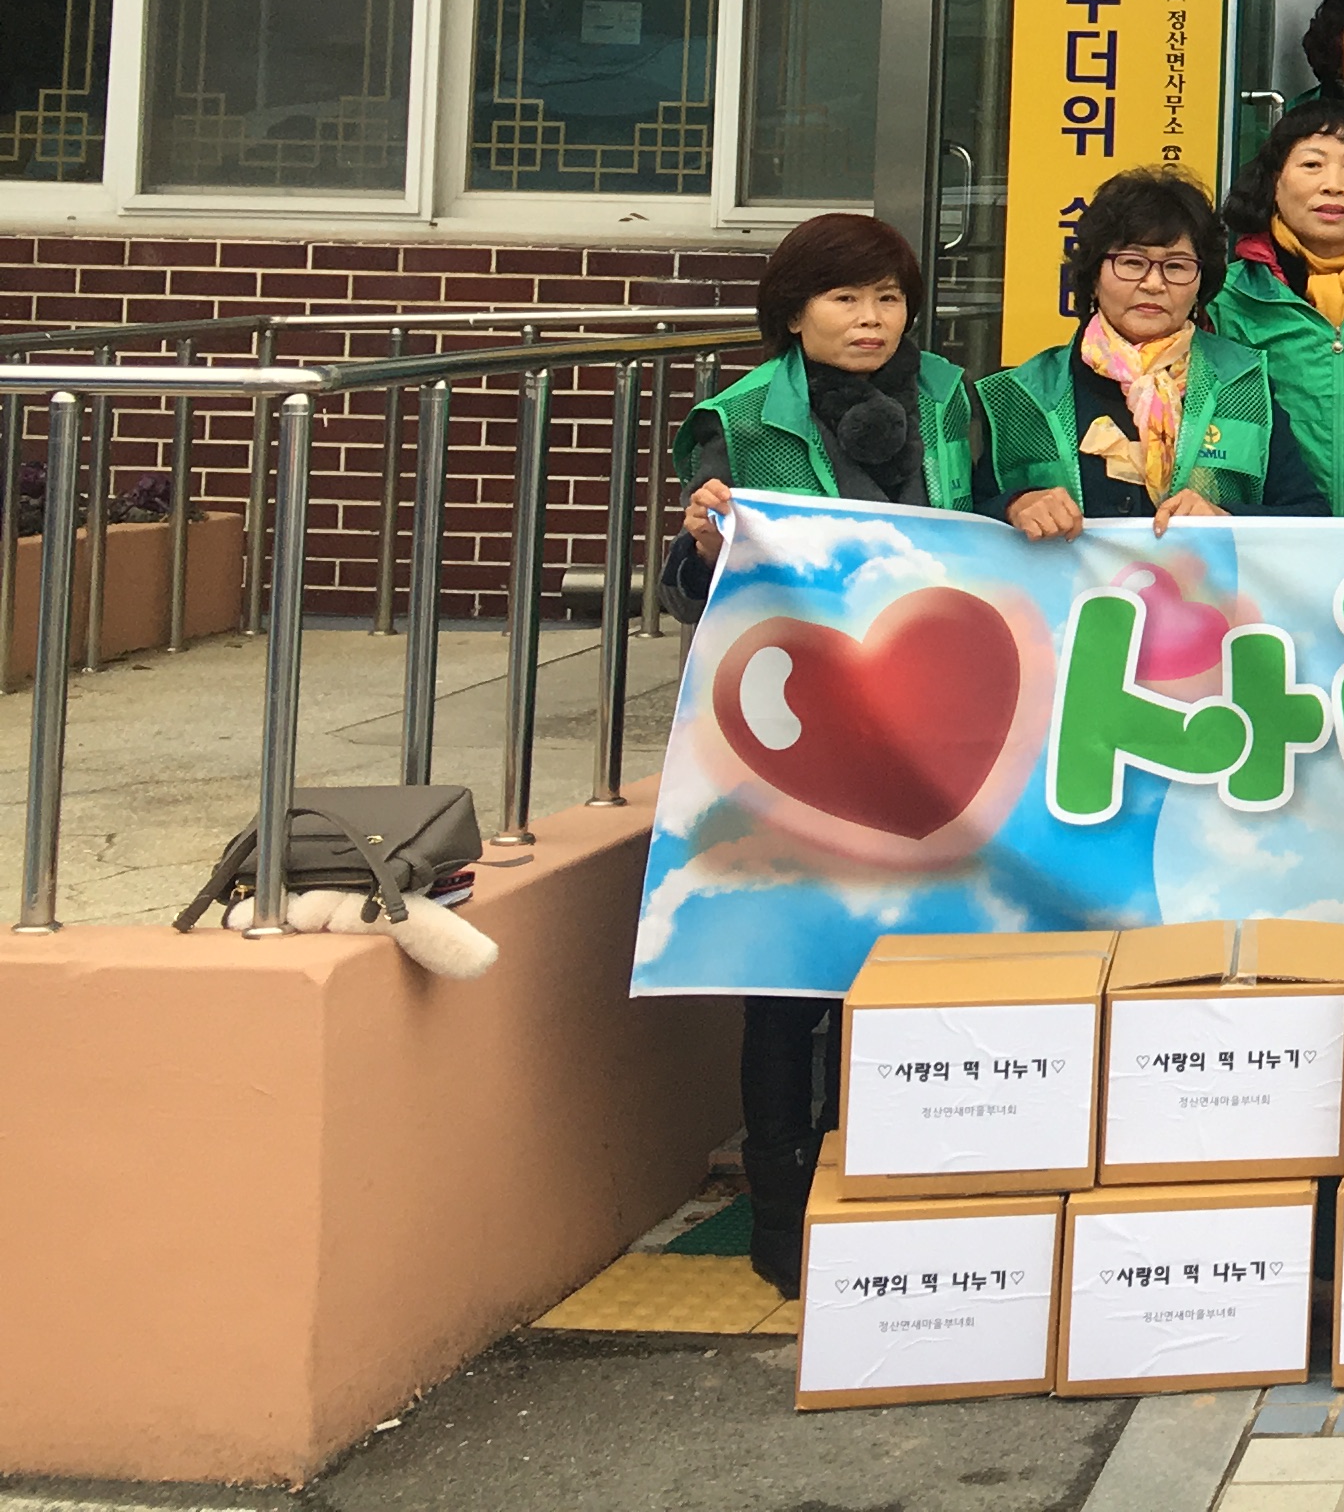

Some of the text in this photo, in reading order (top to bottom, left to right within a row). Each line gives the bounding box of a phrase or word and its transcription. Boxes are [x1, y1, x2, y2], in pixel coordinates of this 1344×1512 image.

[1162, 9, 1188, 135] 정산면사무소
[895, 1058, 1047, 1083] 사랑의 떡 나누기
[1152, 1049, 1300, 1073] 사랑의 떡 나누기
[852, 1270, 1006, 1297] 사랑의 떡 나누기
[1116, 1260, 1266, 1288] 사랑의 떡 나누기
